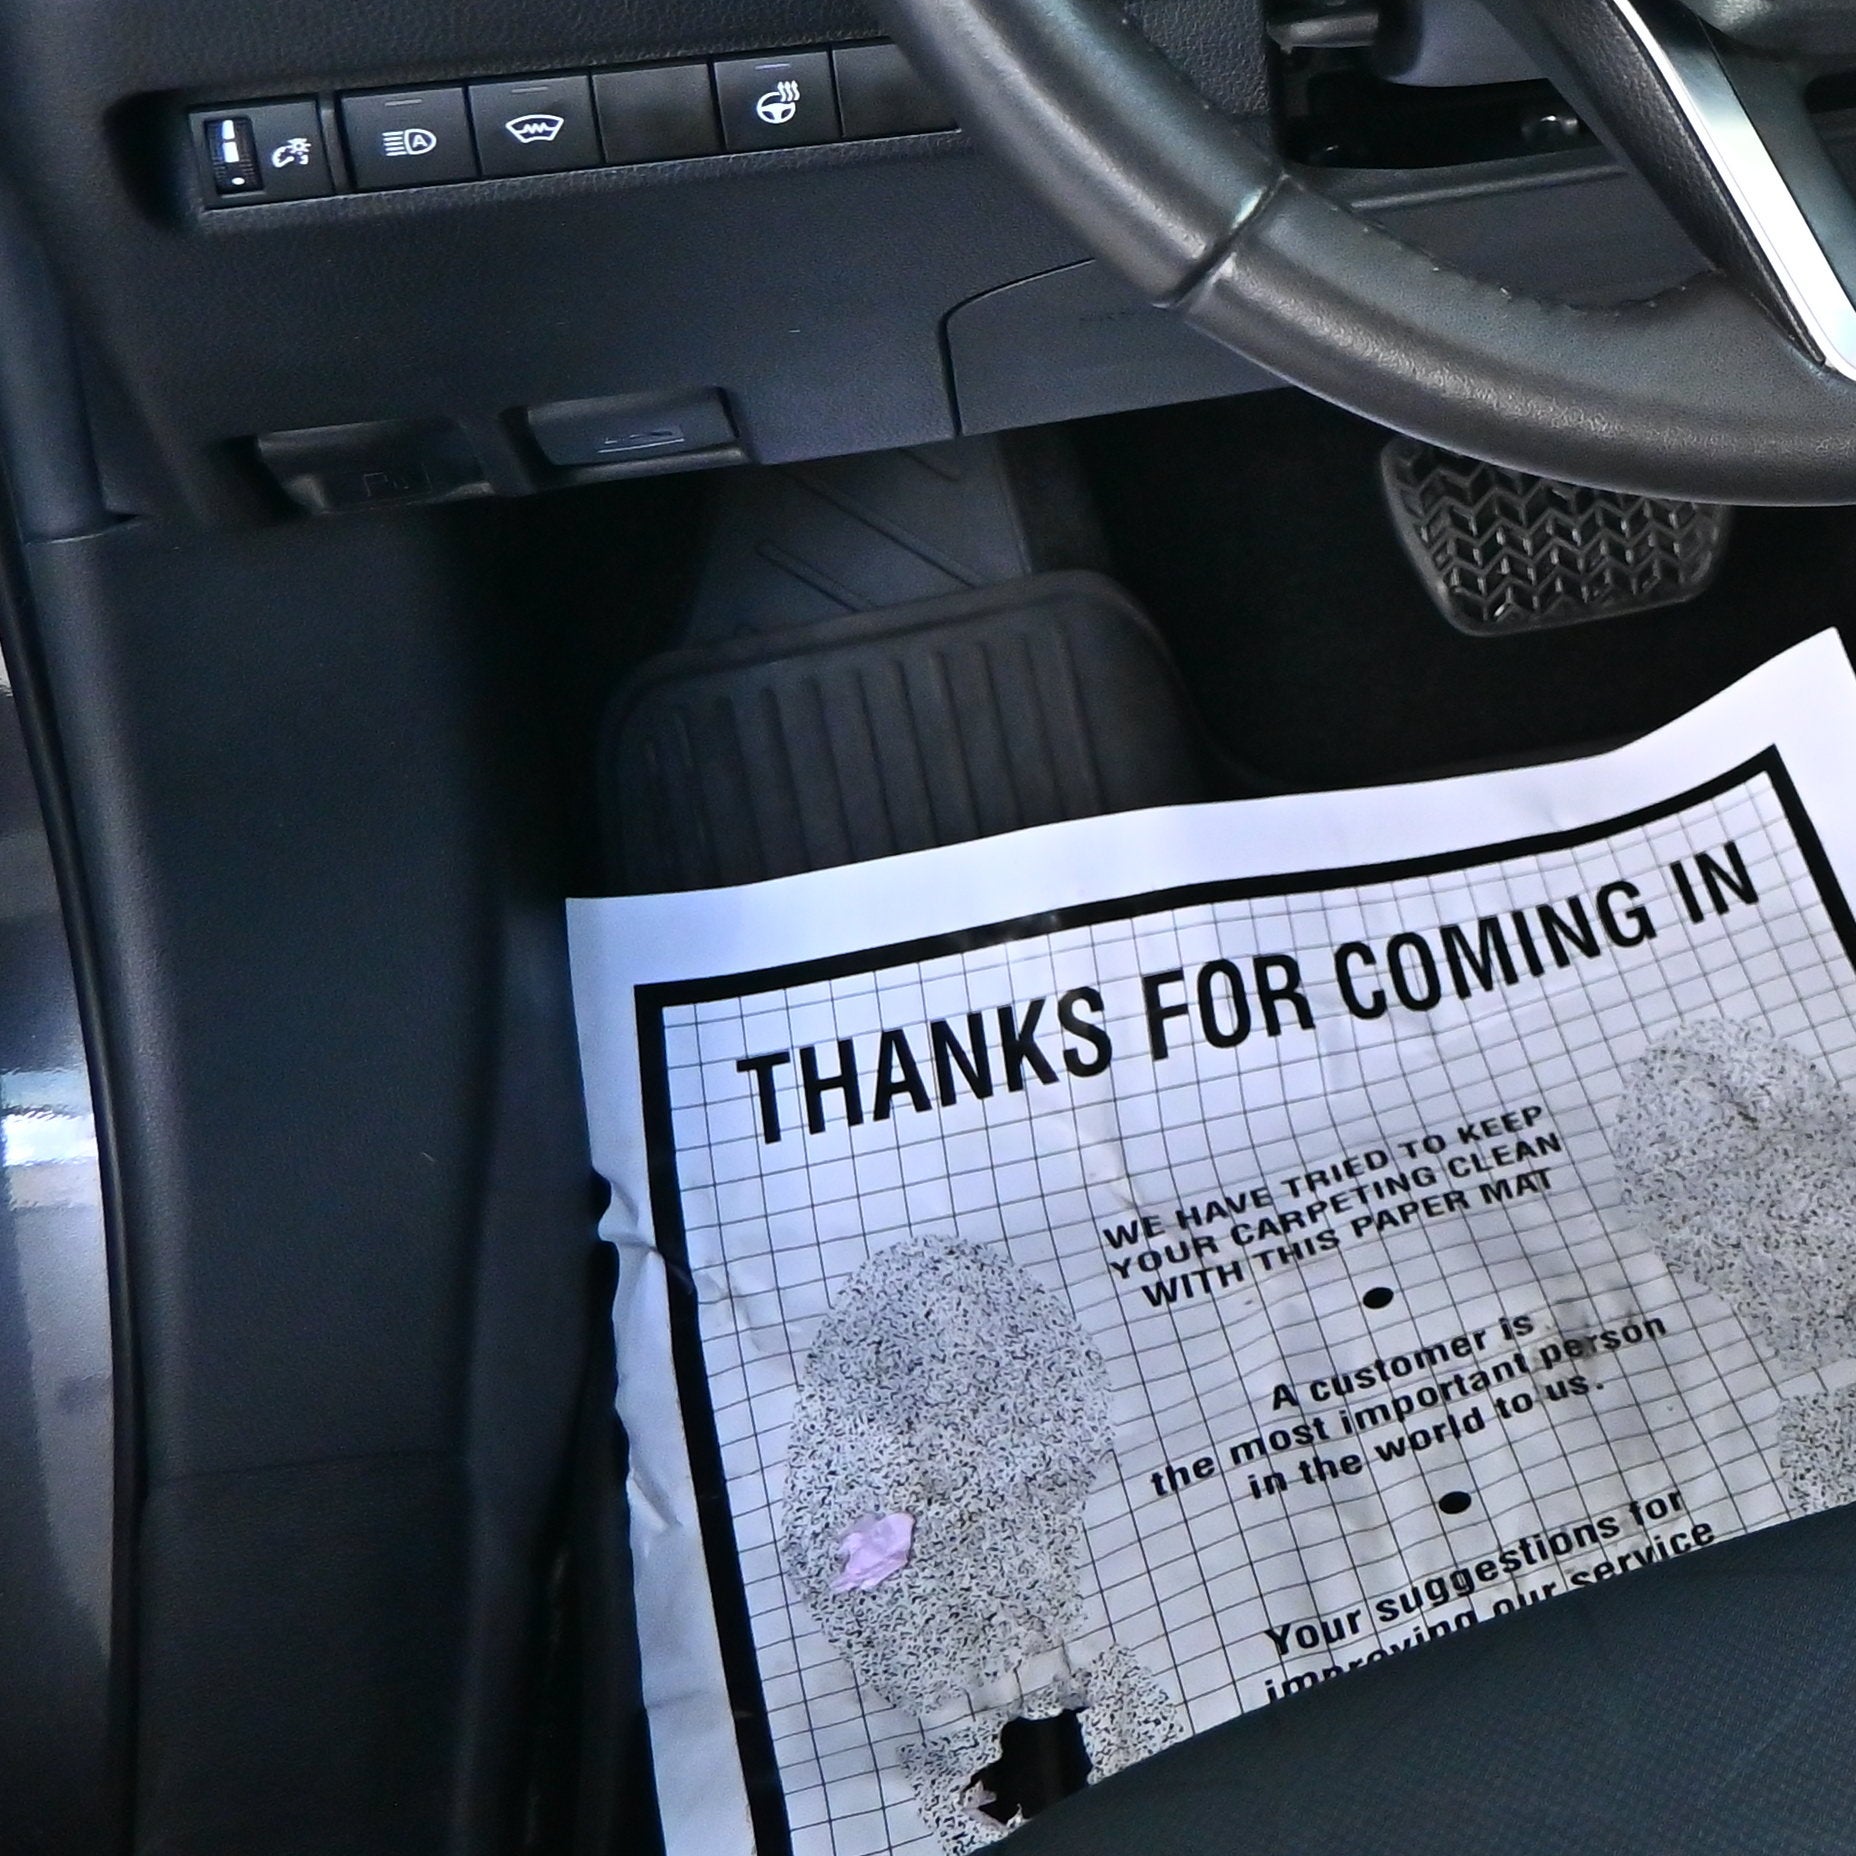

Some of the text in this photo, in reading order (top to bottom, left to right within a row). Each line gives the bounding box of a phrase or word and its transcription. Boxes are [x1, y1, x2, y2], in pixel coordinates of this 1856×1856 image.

[736, 840, 1760, 1145] THANKS FOR COMING IN
[1102, 1104, 1545, 1250] WE HAVE TRIED TO KEEP
[1109, 1131, 1564, 1282] YOUR CARPETING CLEAN
[1140, 1166, 1555, 1310] WITH THIS PAPER MAT
[1150, 1313, 1668, 1498] the most important person
[1247, 1367, 1606, 1501] in the world to us.
[1270, 1312, 1536, 1412] A customer is
[1263, 1488, 1687, 1658] Your suggestions for
[1492, 1578, 1557, 1617] our
[1569, 1521, 1716, 1588] service
